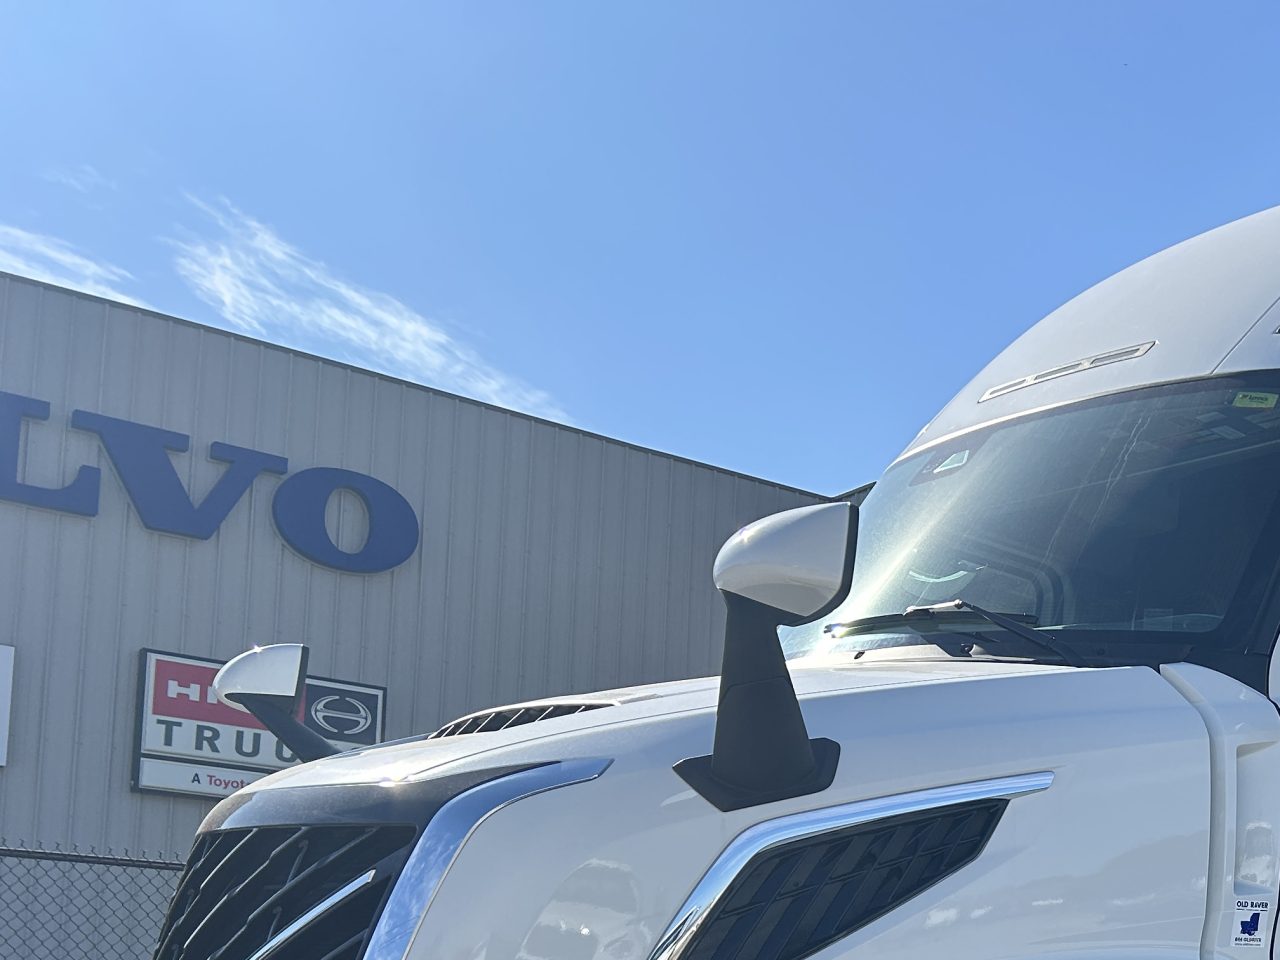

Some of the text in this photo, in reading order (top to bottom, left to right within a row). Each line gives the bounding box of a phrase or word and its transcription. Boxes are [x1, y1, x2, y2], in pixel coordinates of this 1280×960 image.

[0, 391, 420, 574] LVO
[191, 773, 201, 784] A
[1236, 900, 1249, 908] OLD
